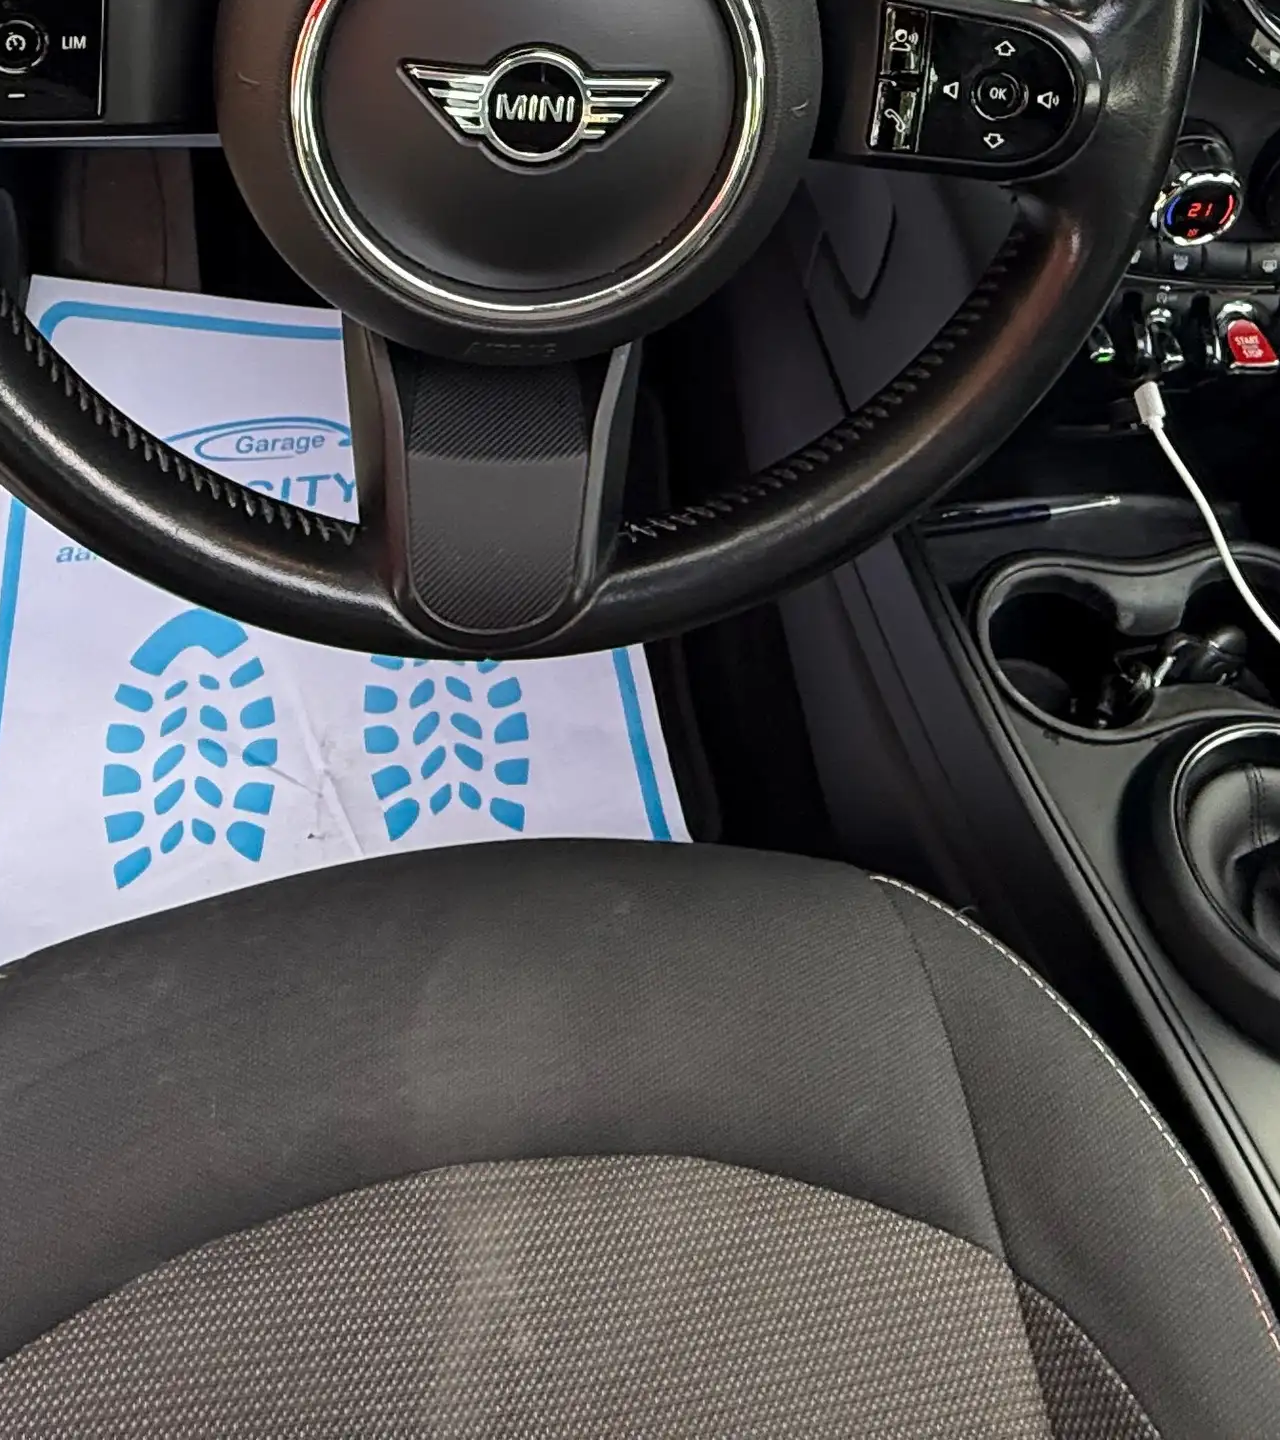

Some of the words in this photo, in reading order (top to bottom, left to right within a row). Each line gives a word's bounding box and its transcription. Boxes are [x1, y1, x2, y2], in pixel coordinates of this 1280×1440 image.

[61, 35, 87, 50] LIM
[989, 86, 1007, 101] OK
[495, 93, 576, 123] MINI
[1187, 202, 1214, 217] 21
[235, 434, 326, 455] Garage
